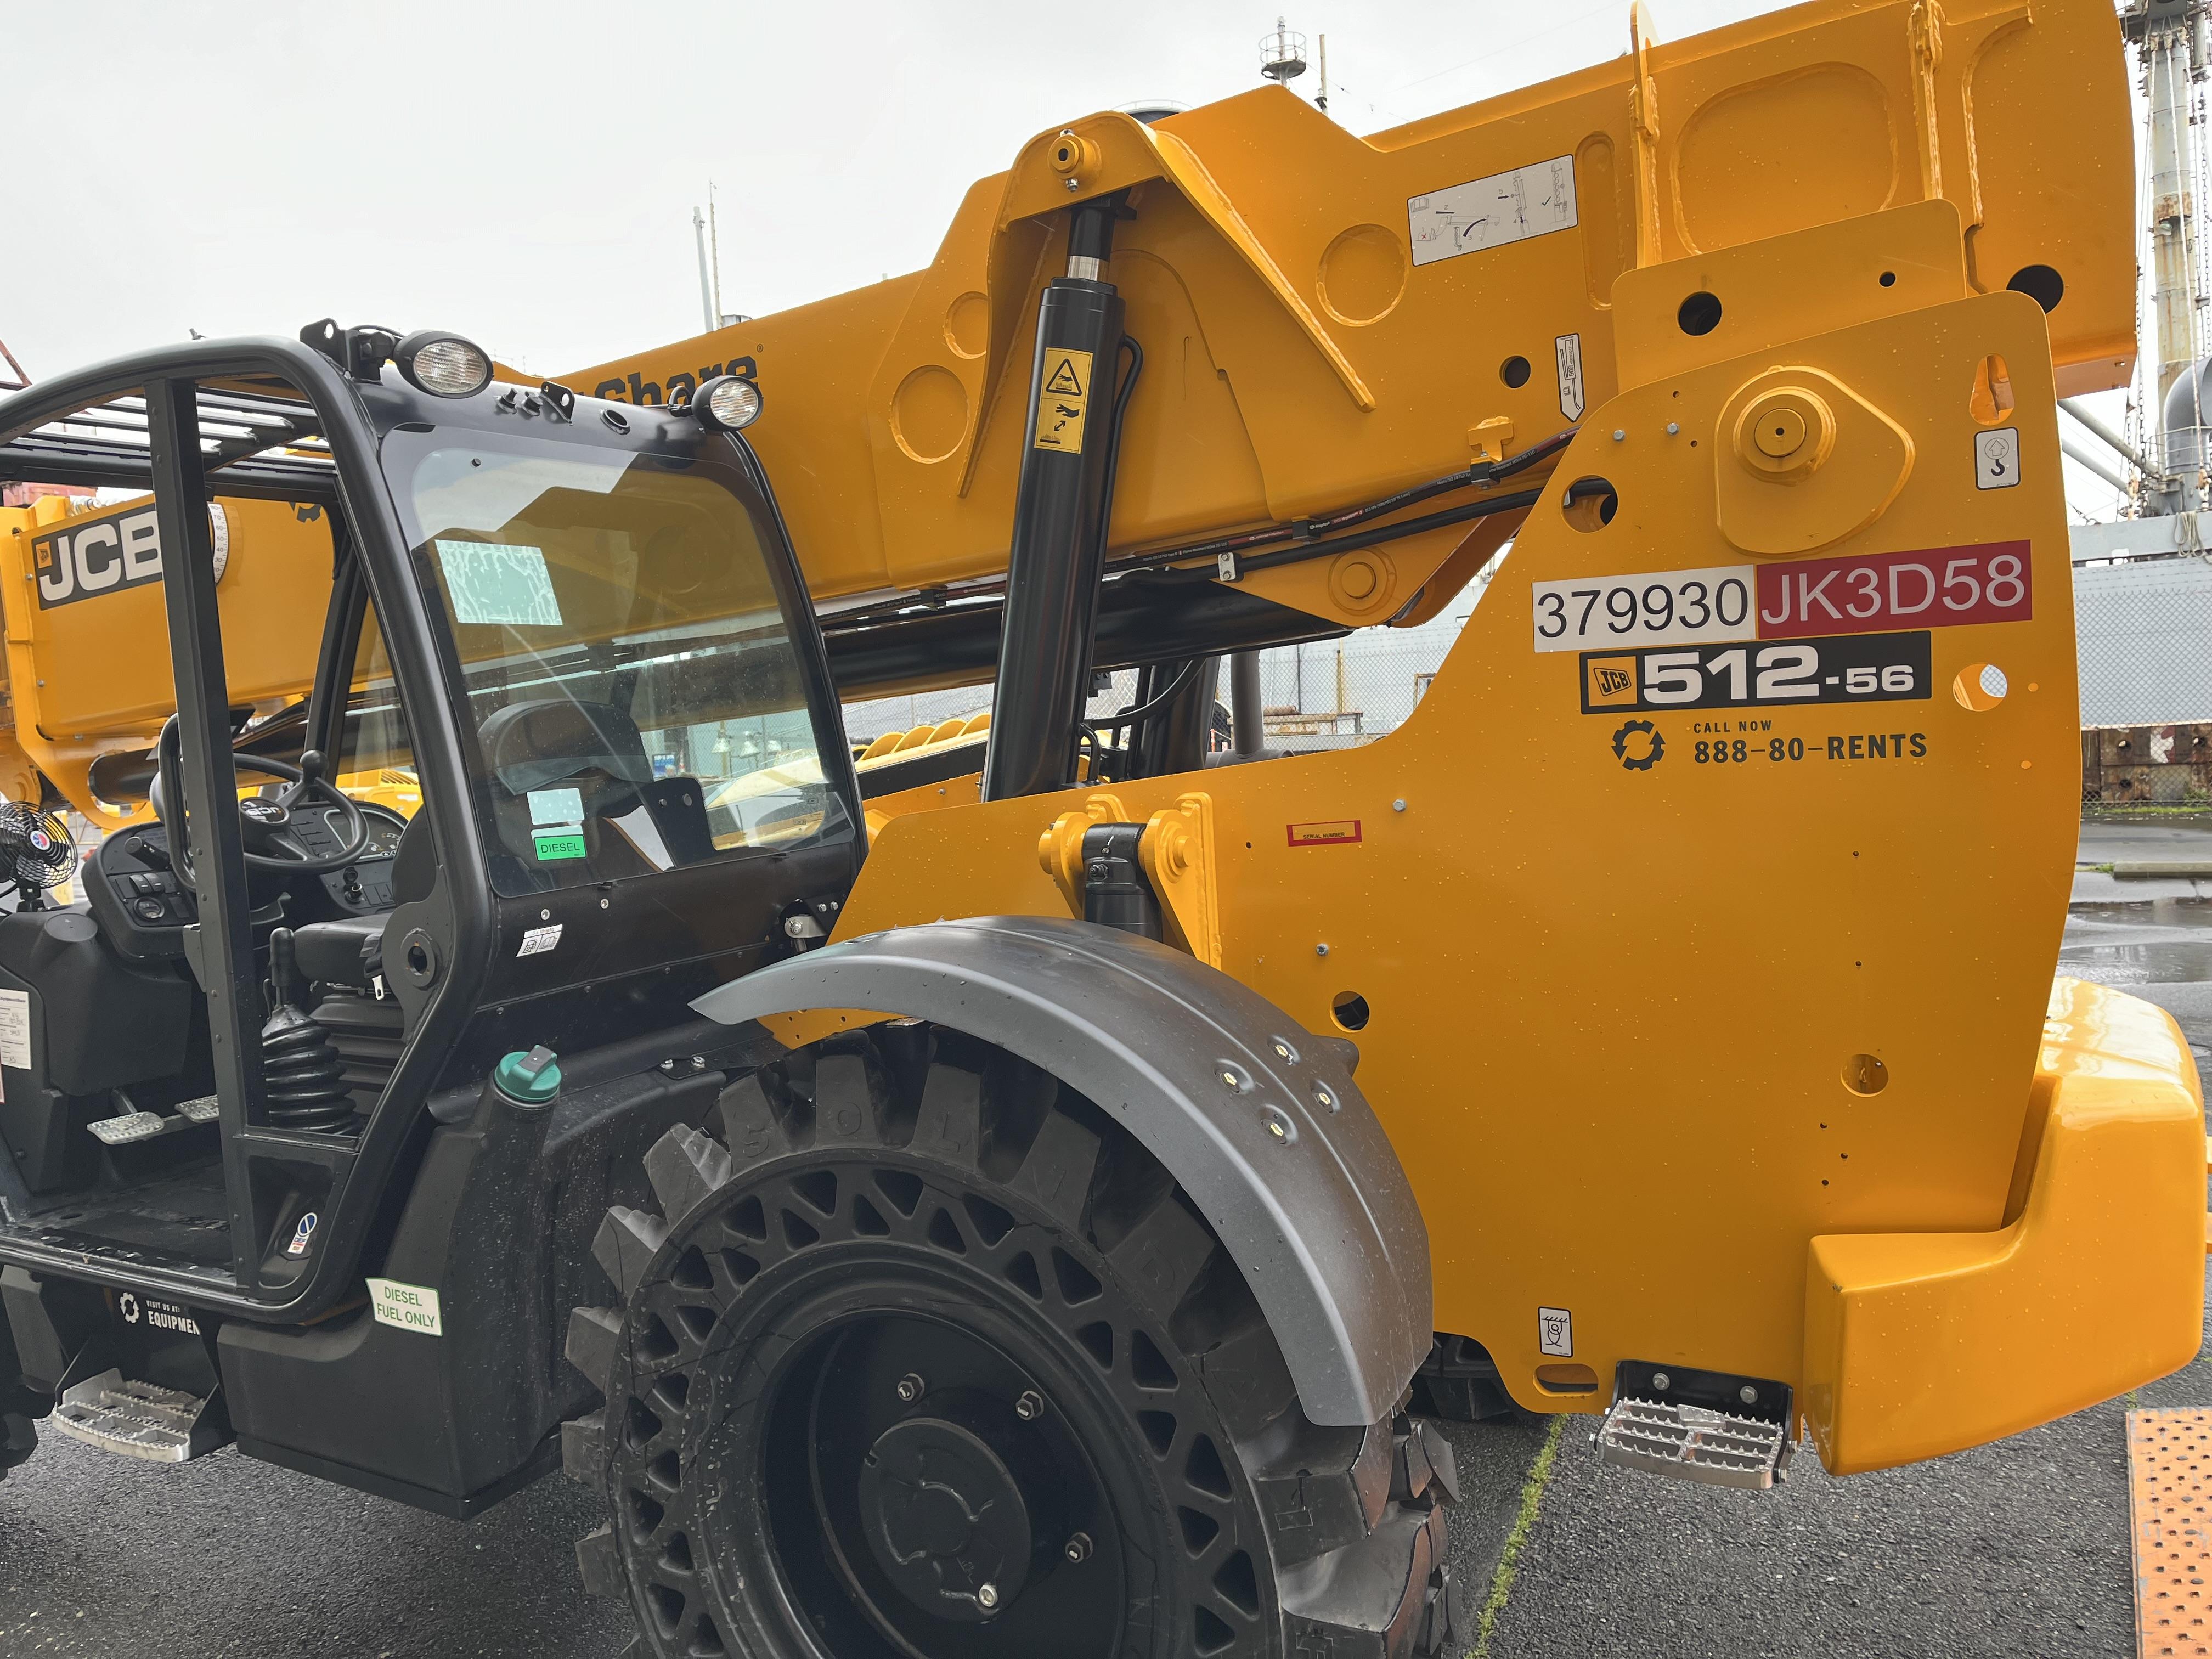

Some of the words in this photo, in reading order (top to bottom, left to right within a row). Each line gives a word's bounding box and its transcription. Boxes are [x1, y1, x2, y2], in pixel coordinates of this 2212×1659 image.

[40, 510, 162, 601] JCB
[1762, 554, 2025, 625] JK3D58
[1537, 578, 1748, 639] 379930
[1600, 670, 1629, 693] JCB
[1643, 645, 1914, 704] 512-56
[1694, 722, 1731, 734] CALL
[1739, 720, 1773, 732] NOW
[1695, 733, 1927, 764] 888-80-RENTS
[540, 843, 580, 853] DIESEL
[146, 1300, 161, 1310] VISIT
[162, 1303, 170, 1312] US
[385, 1286, 422, 1307] DIESEL
[377, 1303, 403, 1321] FUEL
[405, 1311, 435, 1328] ONLY
